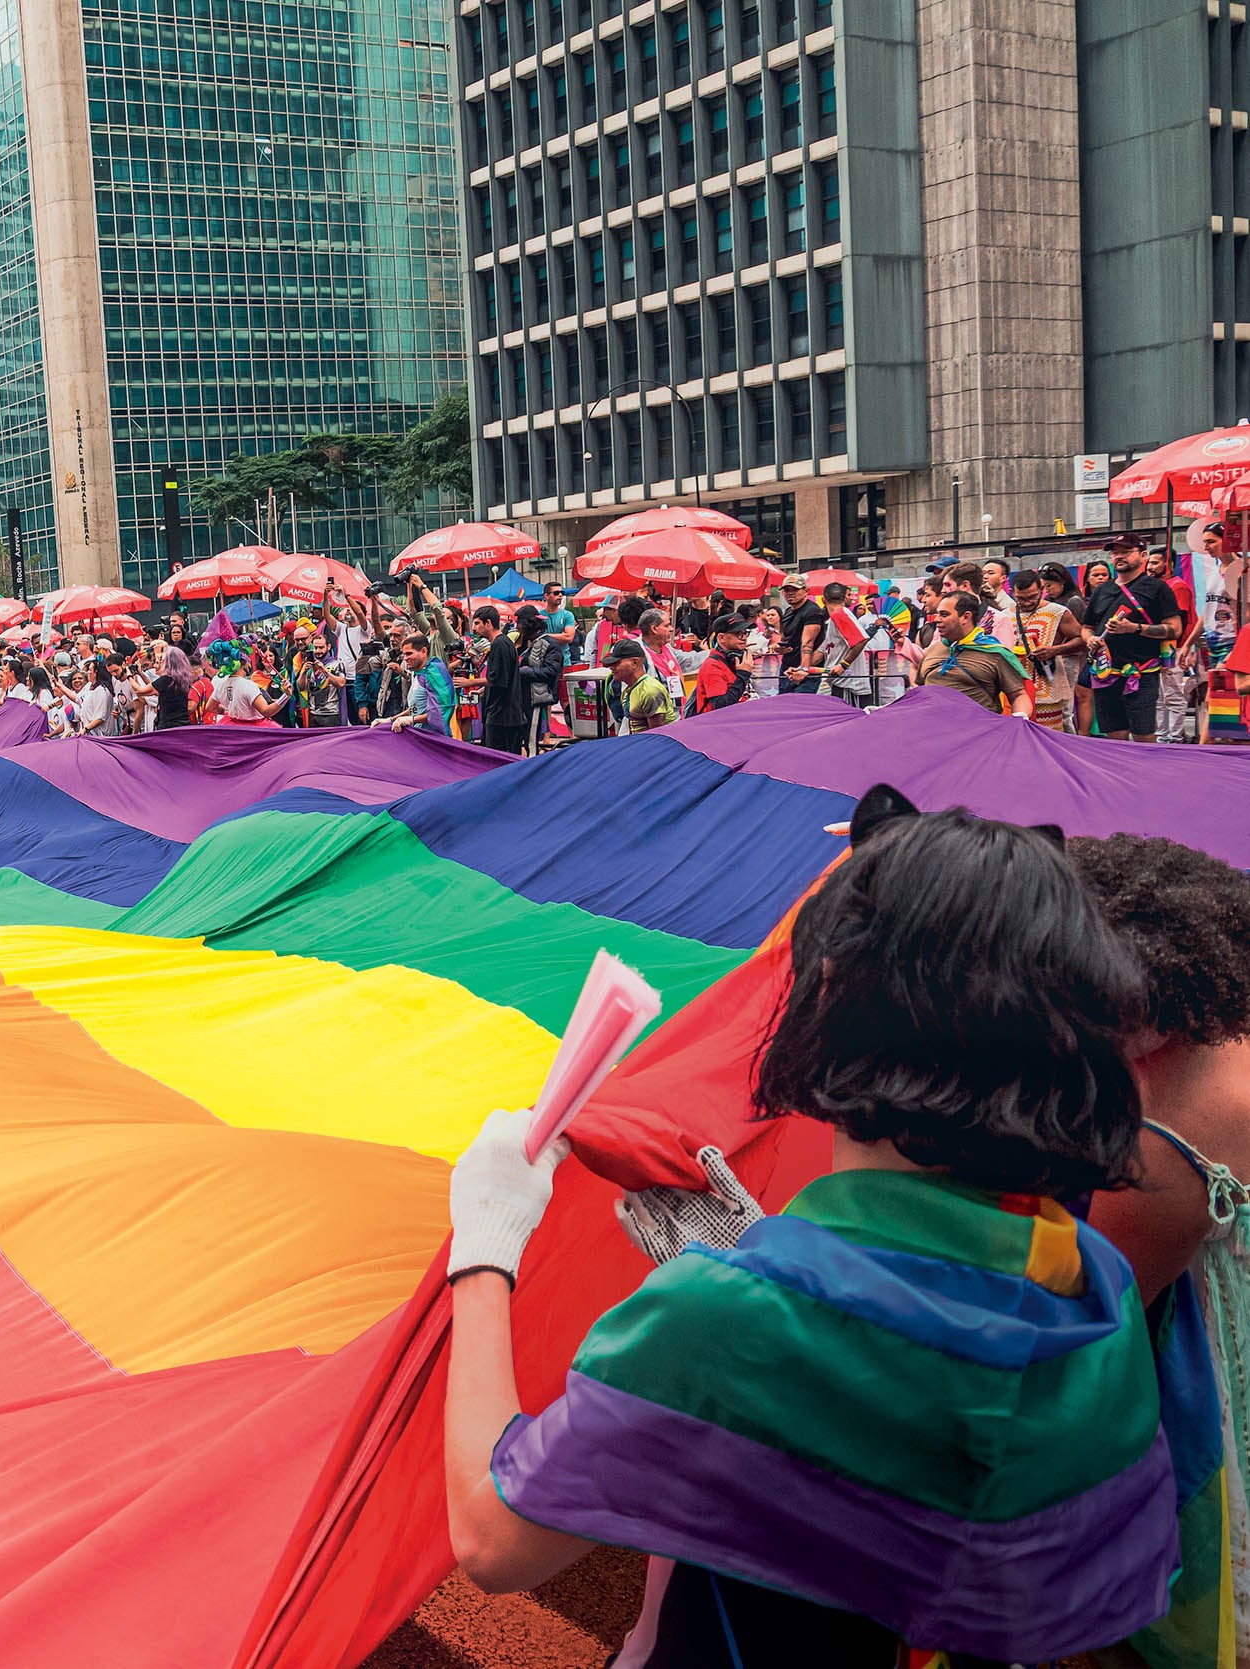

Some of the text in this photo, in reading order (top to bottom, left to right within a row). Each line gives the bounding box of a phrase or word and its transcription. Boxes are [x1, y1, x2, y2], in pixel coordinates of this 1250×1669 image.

[75, 409, 90, 546] TRIBUNAL REGIONAL FEDERAL
[13, 526, 22, 558] Azevedo
[462, 549, 497, 563] AMSTEL
[514, 545, 535, 556] AMSTEL
[643, 567, 677, 580] BRAHMA
[185, 579, 212, 590] AMSTEL
[287, 587, 317, 601] AMSTEL
